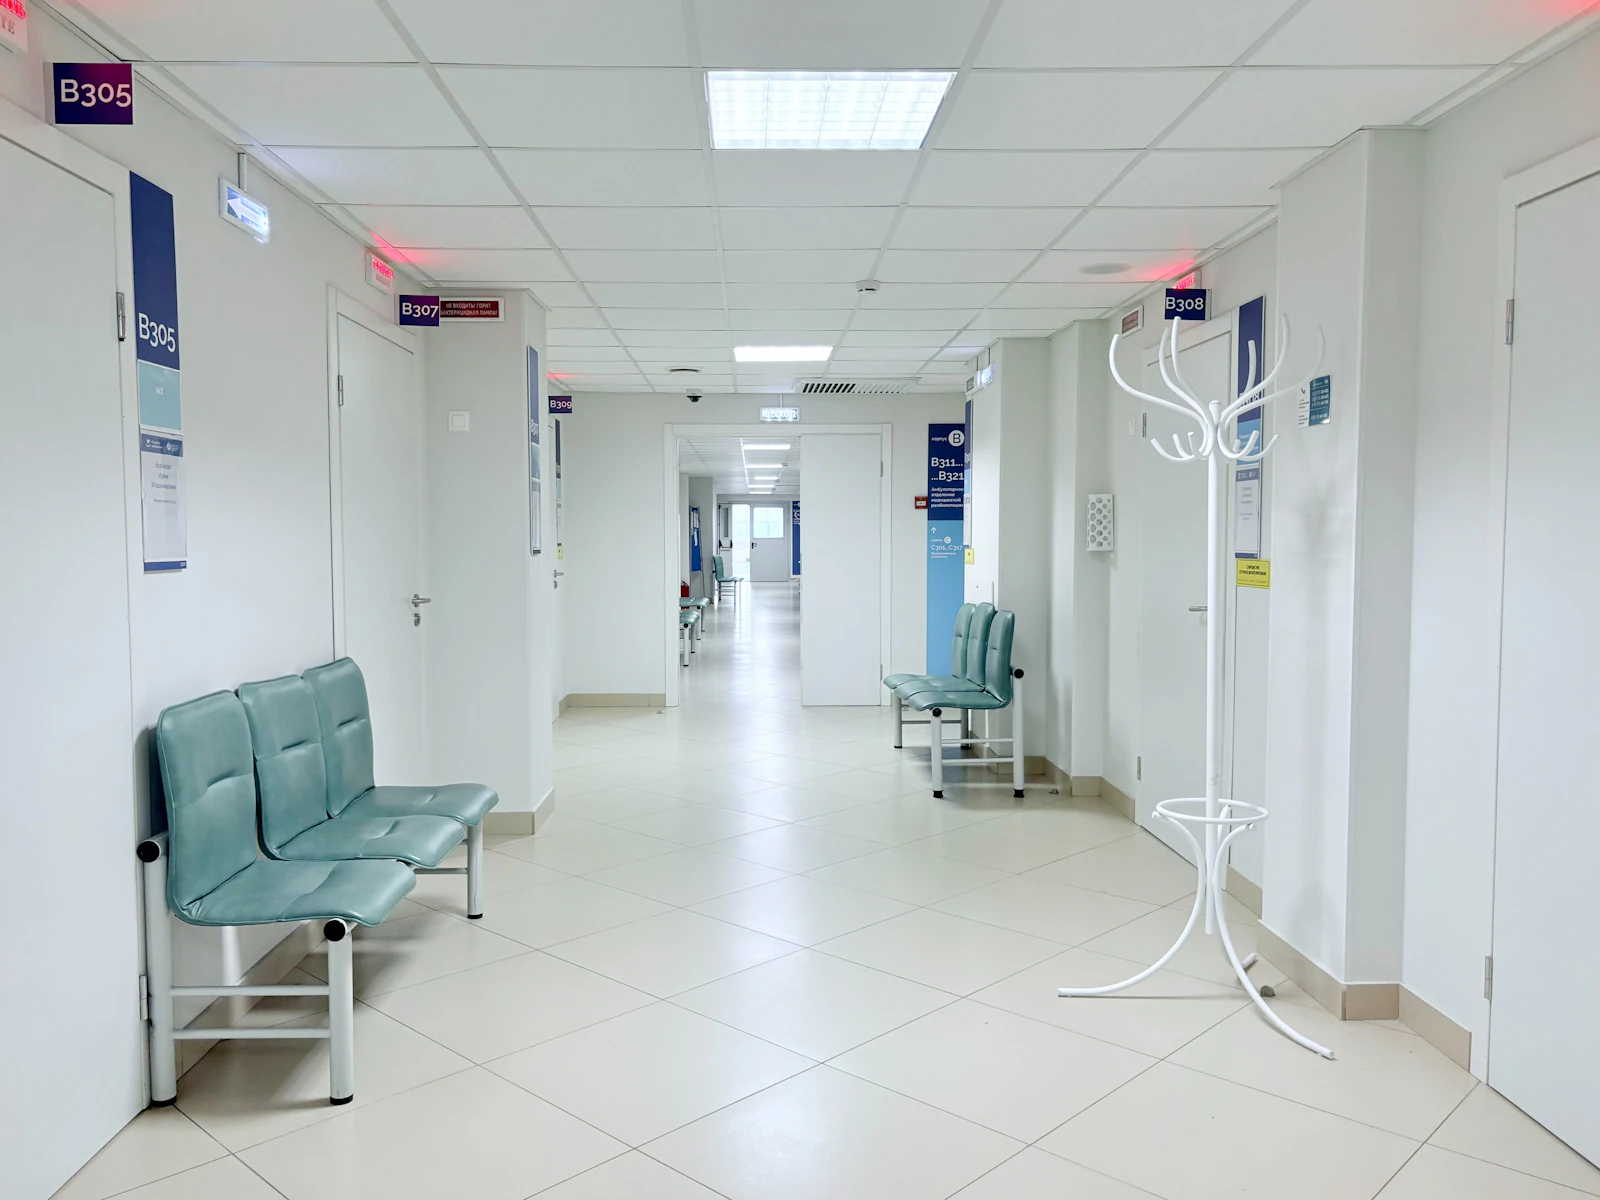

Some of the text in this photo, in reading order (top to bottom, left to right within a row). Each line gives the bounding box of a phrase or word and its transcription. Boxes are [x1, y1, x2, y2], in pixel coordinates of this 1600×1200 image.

[60, 79, 131, 107] B305
[402, 302, 439, 318] B307
[1165, 296, 1204, 312] B308
[138, 312, 176, 353] B305
[550, 400, 572, 409] B309
